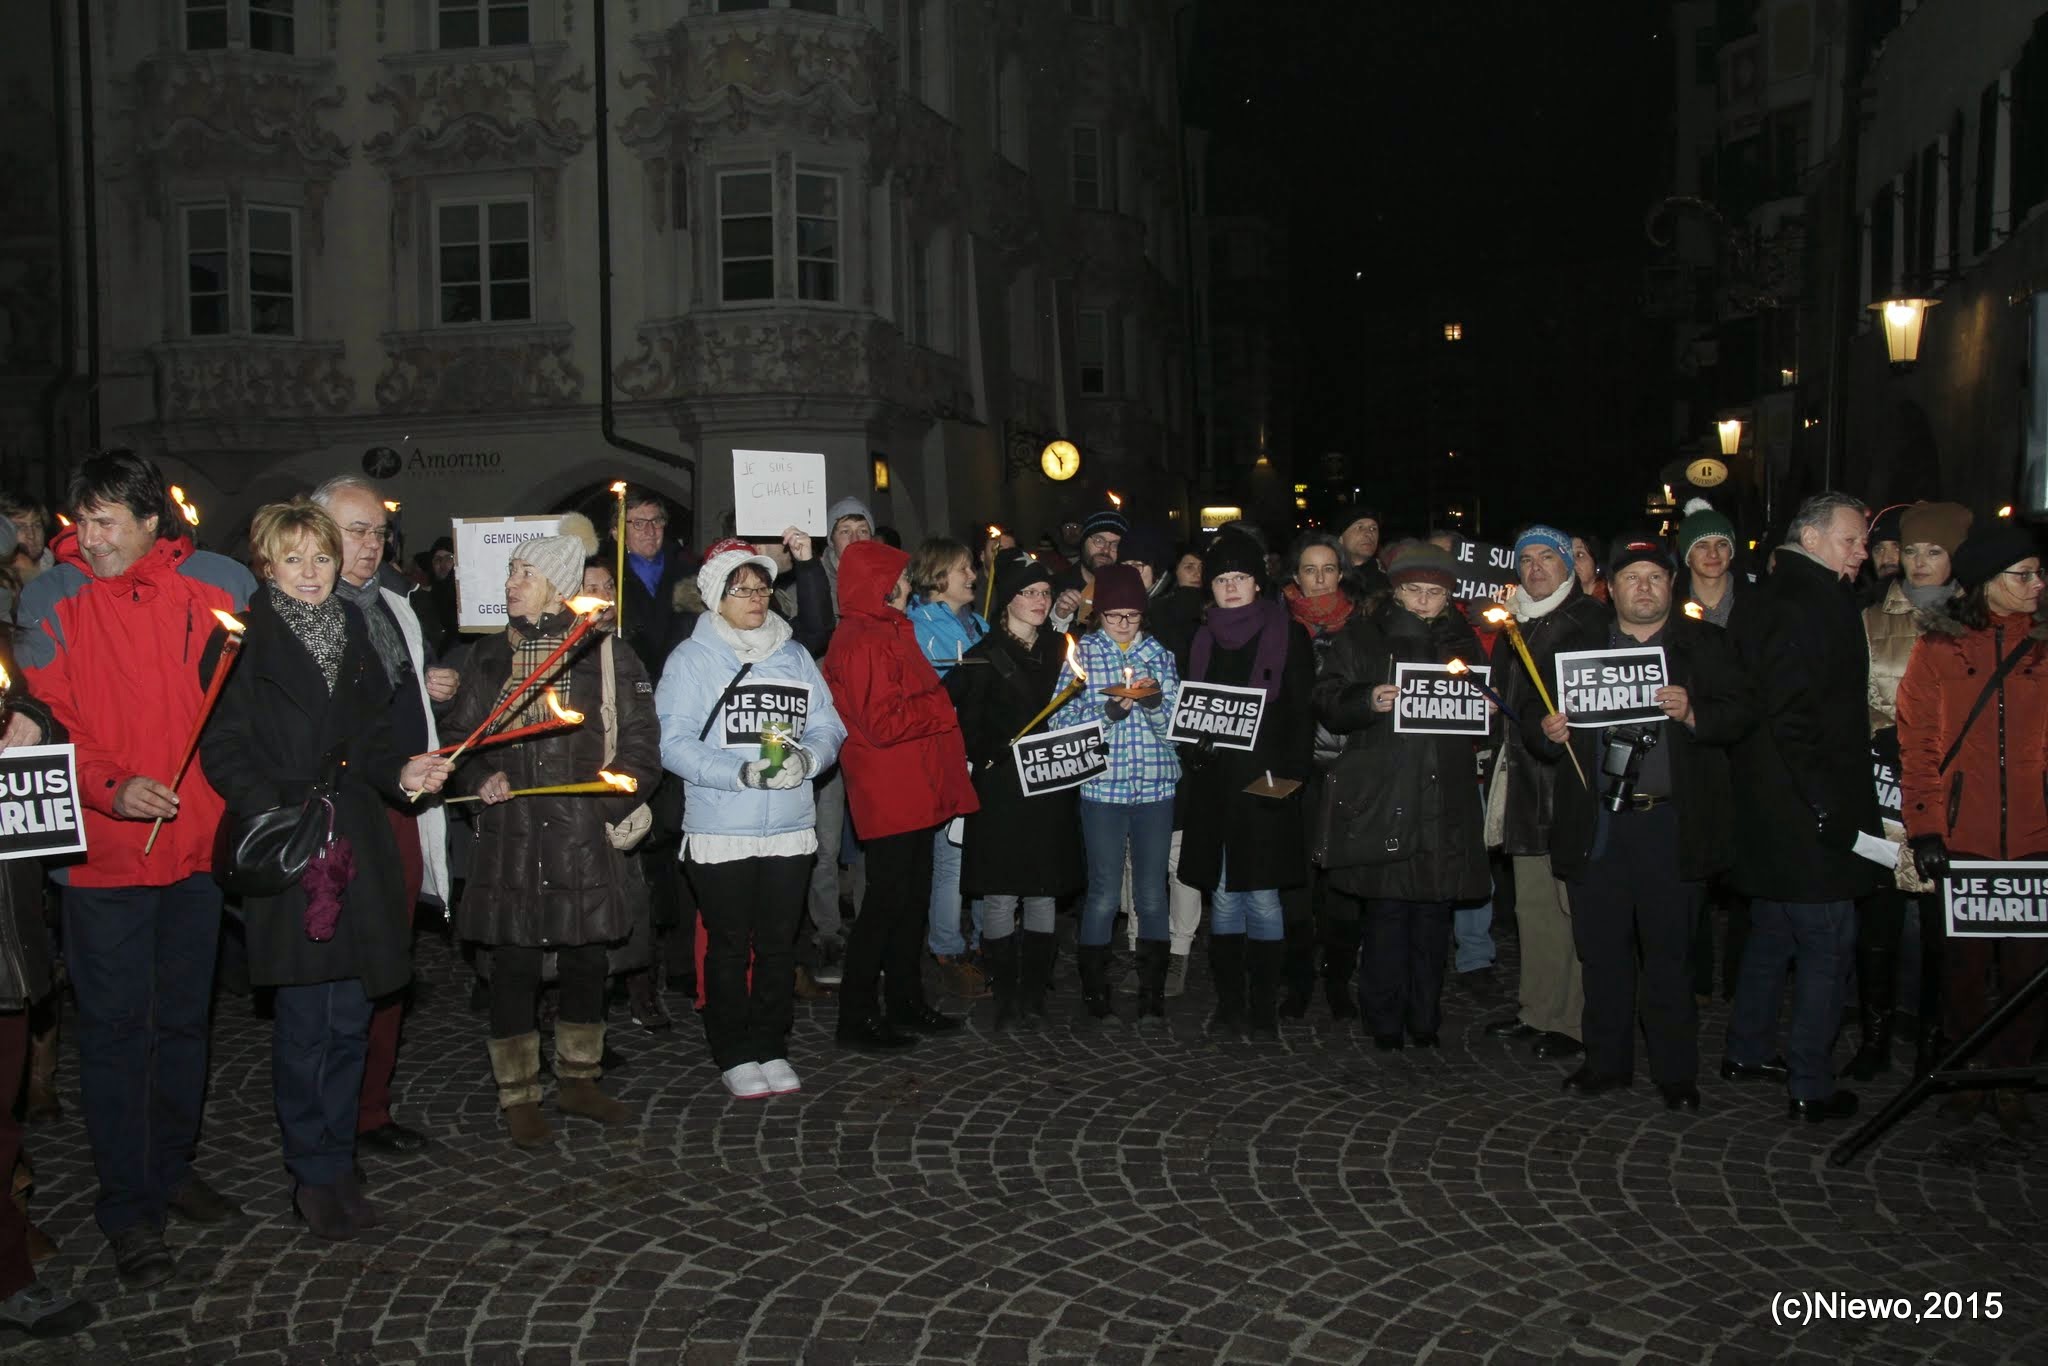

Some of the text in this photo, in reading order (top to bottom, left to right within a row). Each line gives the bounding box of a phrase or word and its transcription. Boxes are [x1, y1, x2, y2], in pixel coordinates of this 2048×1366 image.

[408, 448, 501, 470] Amorino
[752, 480, 815, 499] CHARLIE
[1457, 542, 1476, 563] JE
[1564, 664, 1662, 687] JE SUIS
[1401, 679, 1430, 695] JE
[726, 693, 807, 715] JE SUIS
[1180, 694, 1259, 717] JE SUIS
[1400, 696, 1485, 721] CHARLIE
[1175, 708, 1256, 738] CHARLIE
[1022, 736, 1100, 765] JE SUIS
[0, 797, 76, 836] RLIE
[1952, 878, 1989, 895] JE
